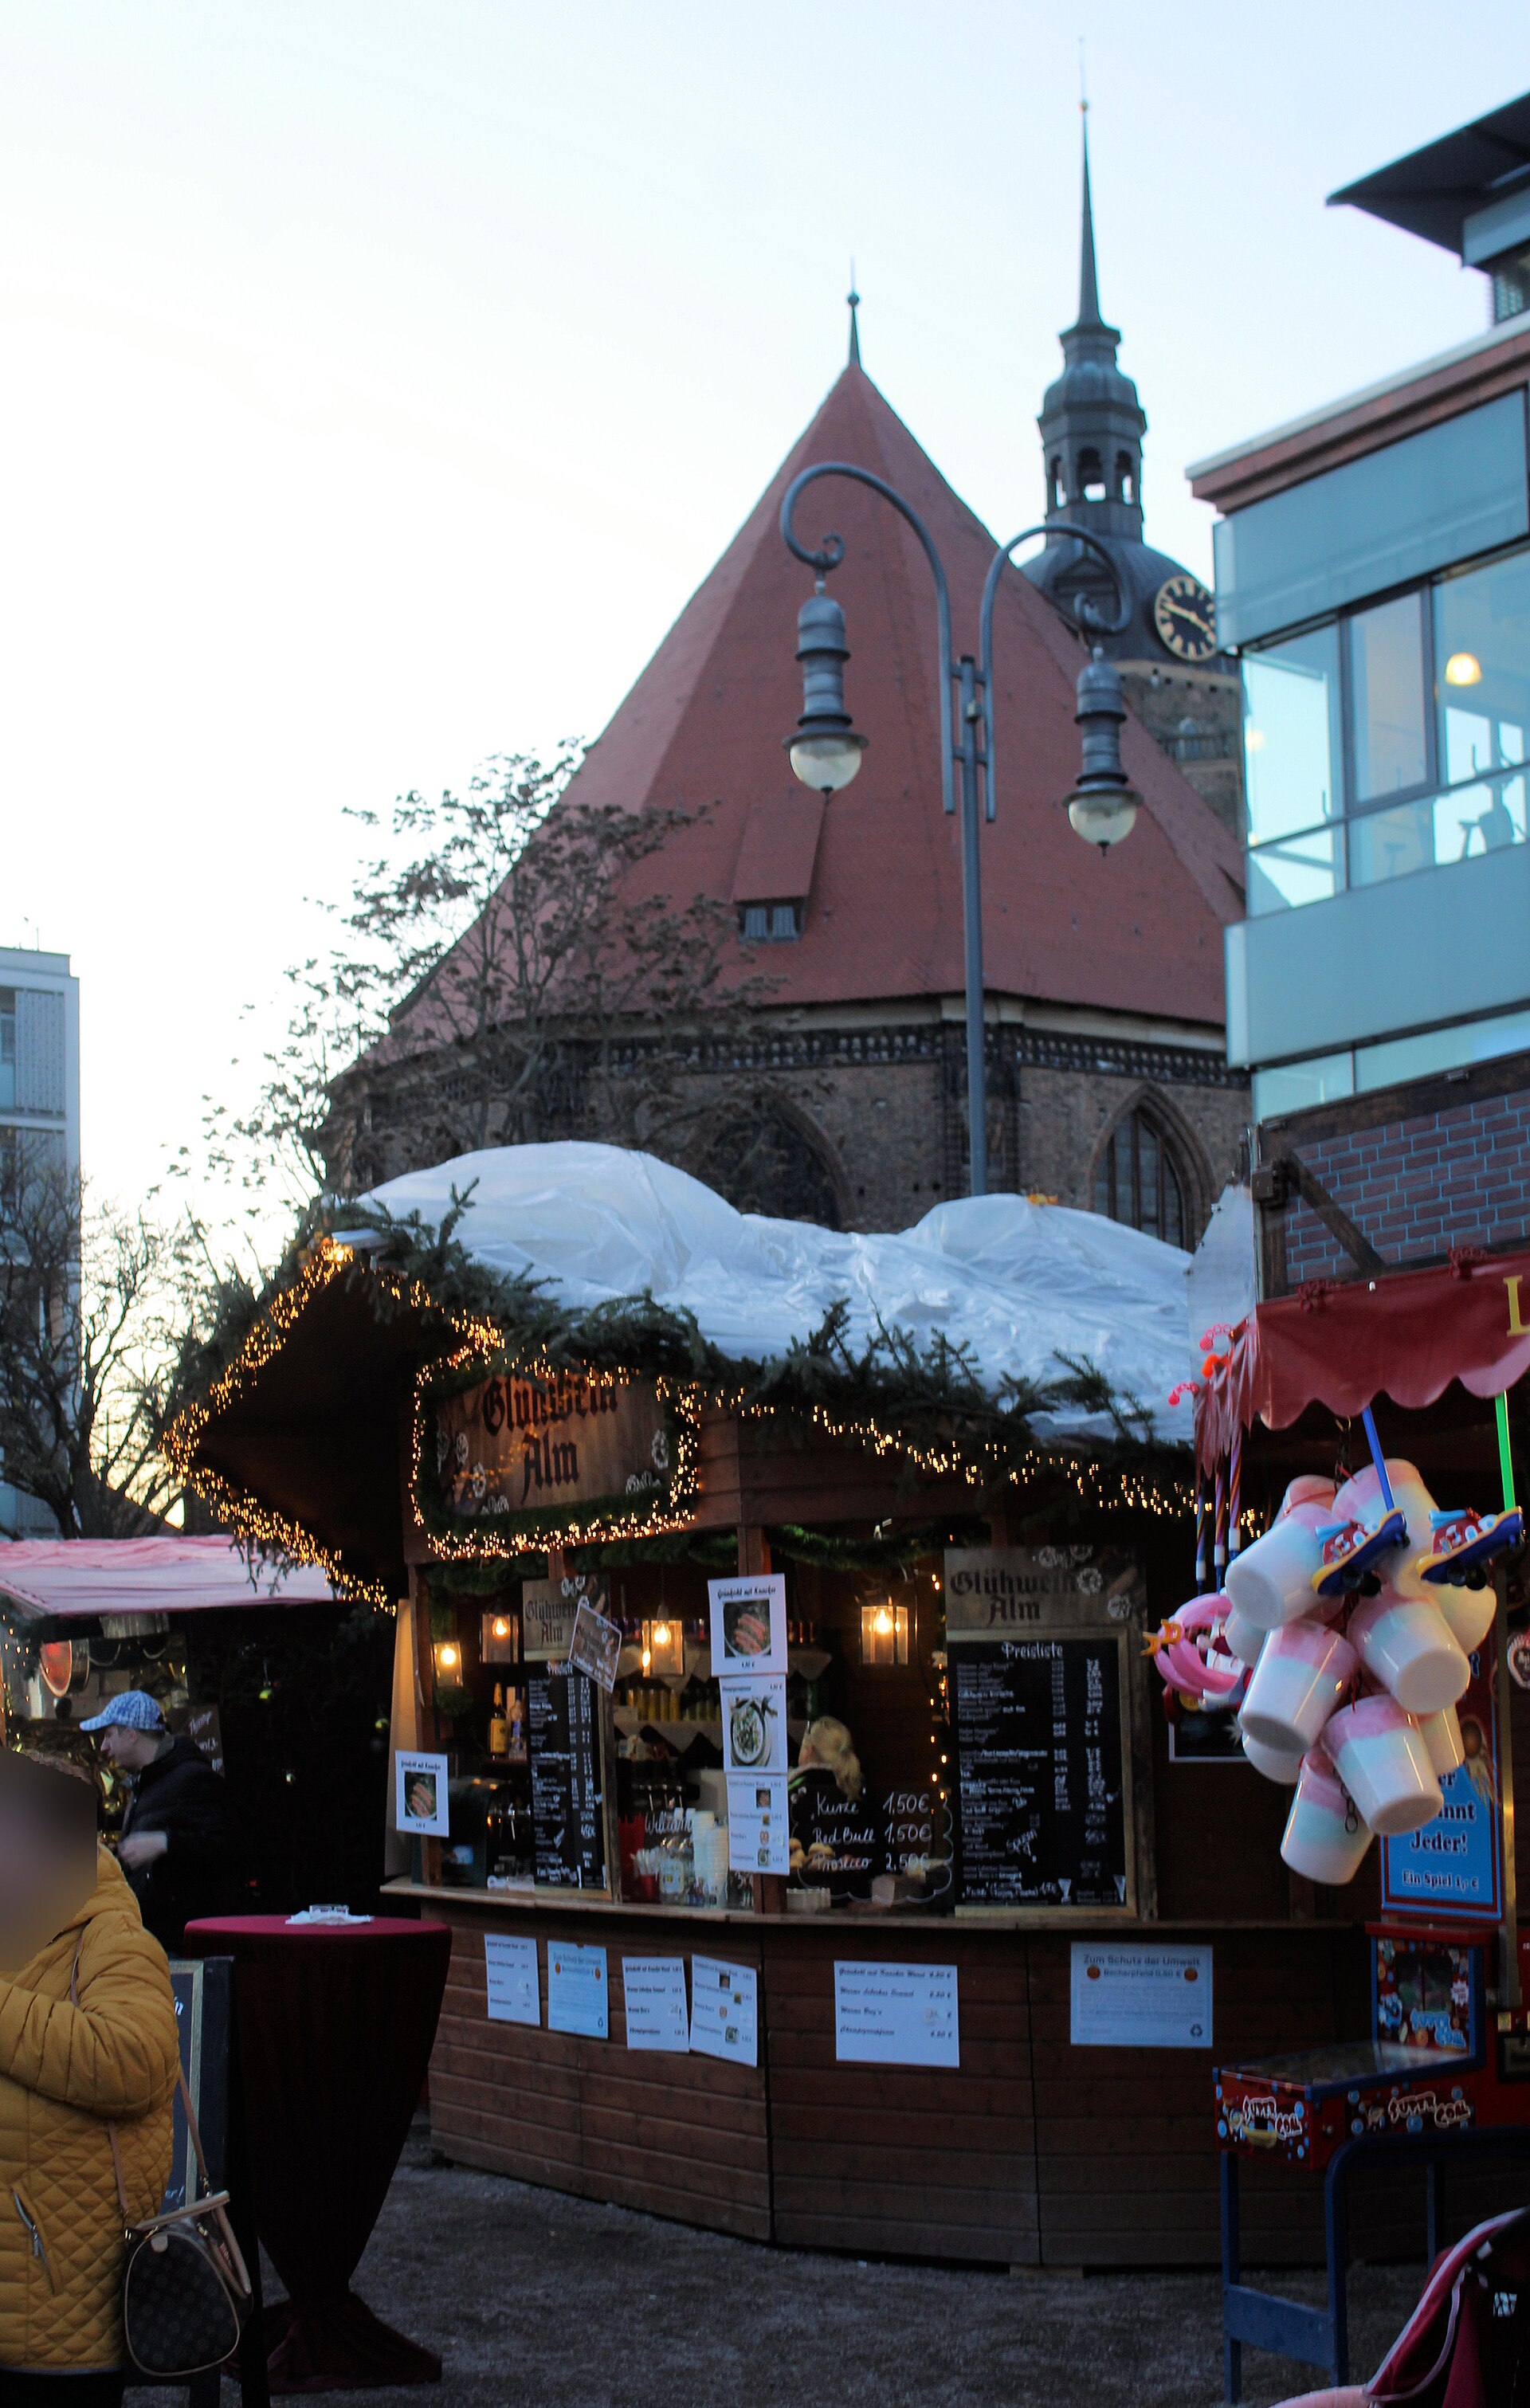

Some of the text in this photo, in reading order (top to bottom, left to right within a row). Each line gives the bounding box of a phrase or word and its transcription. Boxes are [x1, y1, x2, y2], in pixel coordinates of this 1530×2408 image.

[521, 1429, 579, 1505] Alm
[988, 1596, 1041, 1626] Alm
[540, 1621, 563, 1647] Alm
[1002, 1641, 1062, 1660] Preisliste
[813, 1825, 838, 1845] Red
[842, 1826, 876, 1845] Bull
[1410, 1829, 1467, 1853] Jeder!
[1402, 1870, 1422, 1887] Ein
[1424, 1871, 1453, 1890] Spiel
[1084, 1955, 1200, 1966] Zum Schutz der Umwelt
